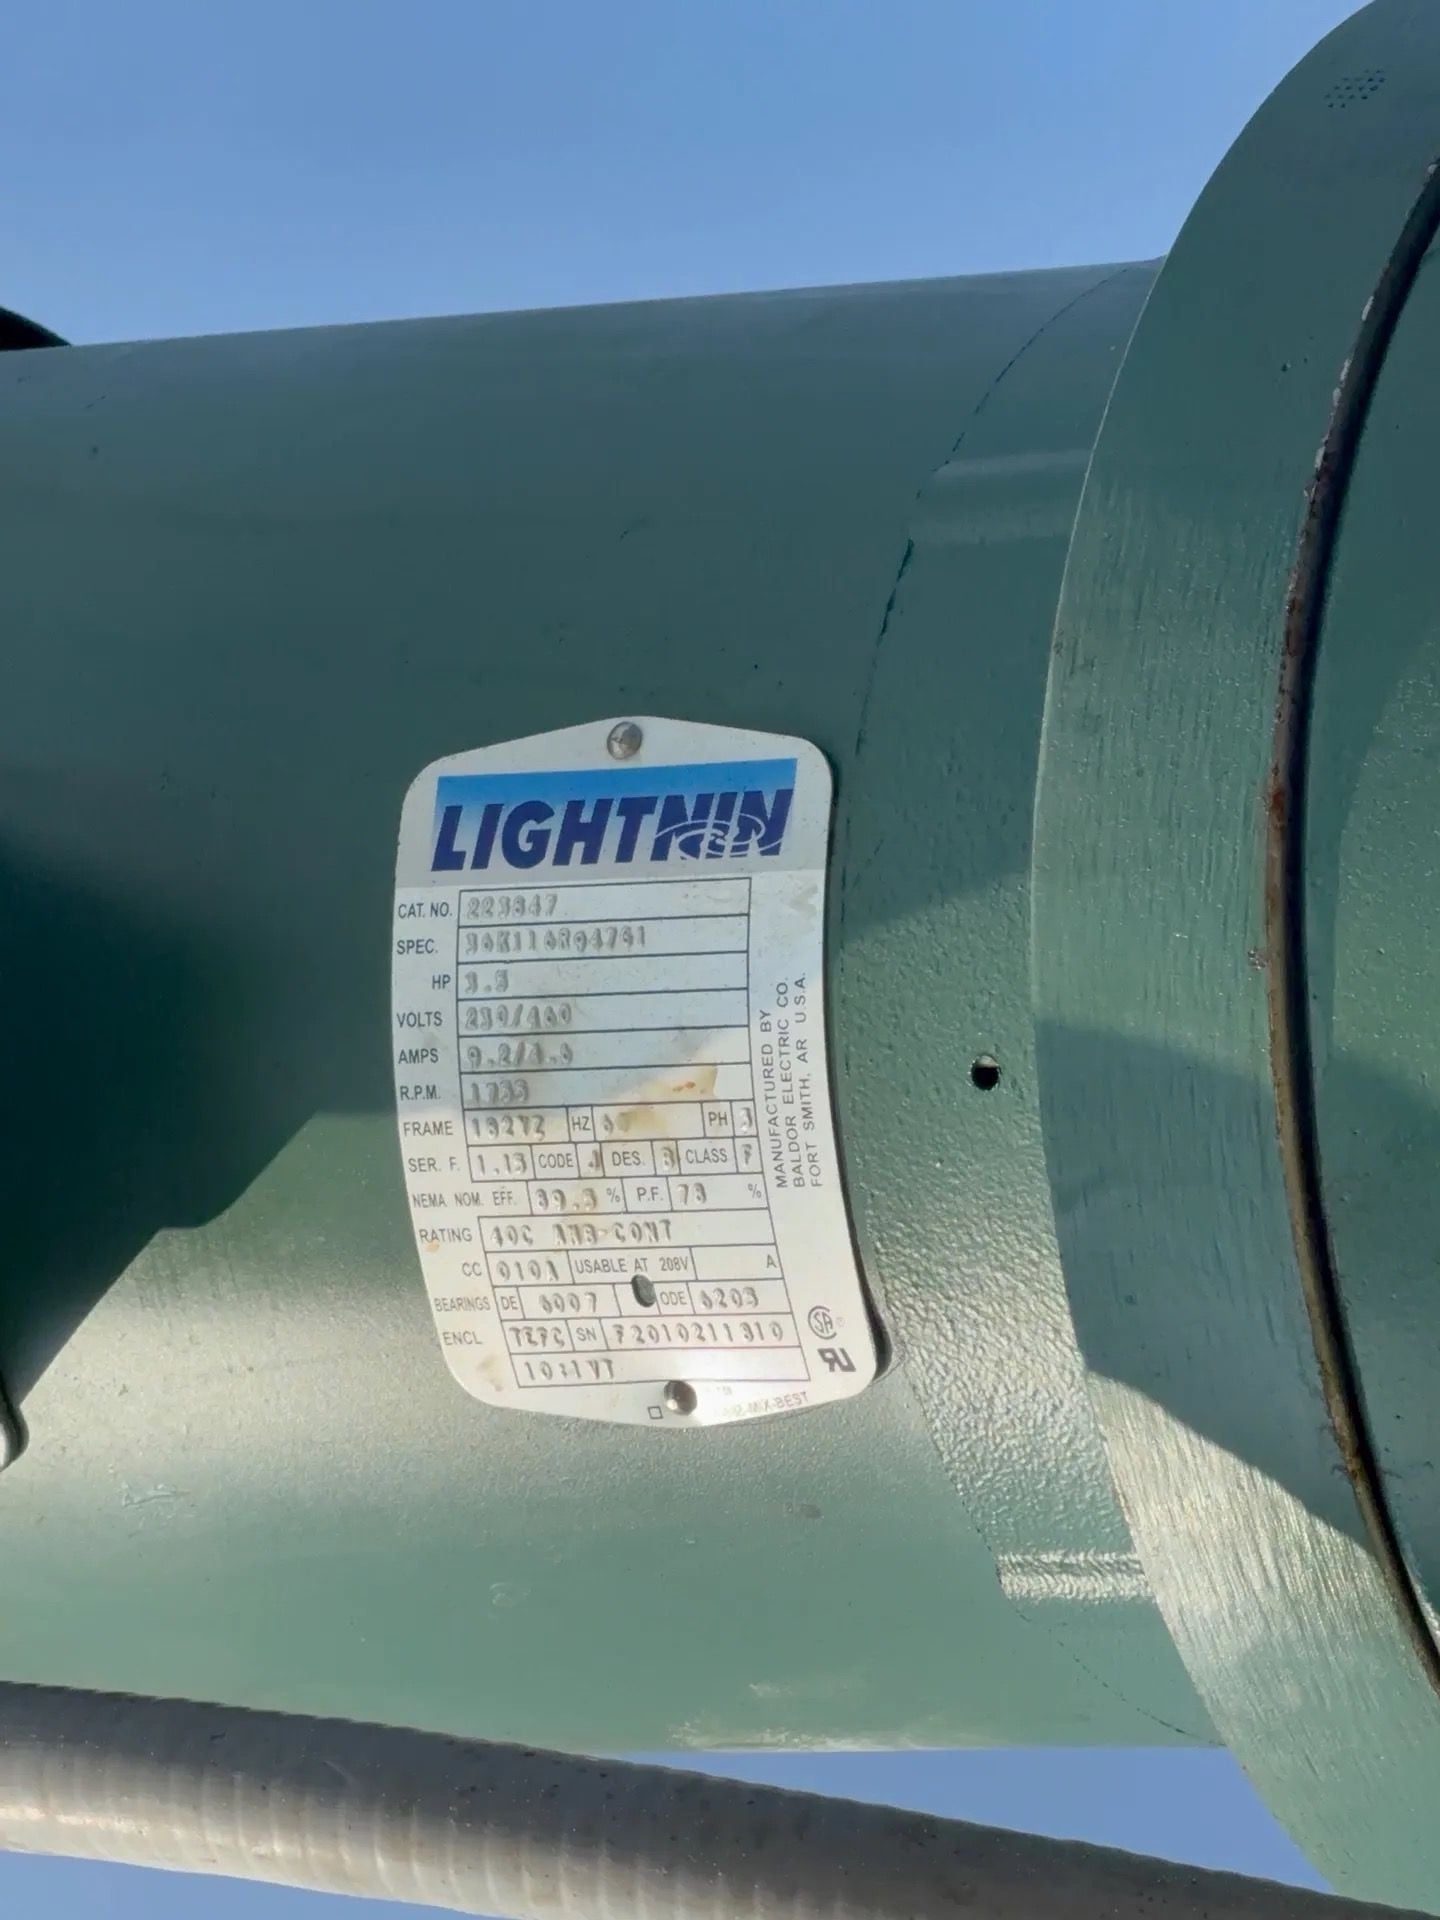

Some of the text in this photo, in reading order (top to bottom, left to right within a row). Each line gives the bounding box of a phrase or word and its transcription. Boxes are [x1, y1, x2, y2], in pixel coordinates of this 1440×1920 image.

[431, 789, 794, 871] LIGHTNIN
[398, 903, 426, 918] CAT.
[430, 902, 453, 917] NO.
[397, 939, 439, 956] SPEC.
[432, 976, 451, 990] HP
[397, 1012, 443, 1028] VOLTS
[398, 1049, 439, 1064] AMPS
[796, 1038, 808, 1063] AR
[400, 1084, 441, 1100] R.P.M.
[776, 977, 805, 1188] BALDOR ELECTRIC CO.
[759, 1009, 788, 1189] MANUFACTURED BY
[403, 1121, 454, 1136] FRAME
[571, 1115, 591, 1131] HZ
[707, 1112, 728, 1127] PH
[408, 1158, 439, 1172] SER.
[449, 1156, 461, 1170] F.
[538, 1153, 574, 1169] CODE
[611, 1151, 645, 1166] DES.
[685, 1148, 727, 1165] CLASS
[806, 1142, 823, 1188] FORT
[412, 1194, 447, 1208] NEMA
[454, 1192, 483, 1206] NOM.
[492, 1190, 517, 1205] EFF.
[606, 1187, 621, 1203] %
[636, 1185, 666, 1202] P.F.
[747, 1184, 762, 1199] %
[420, 1227, 473, 1243] RATING
[462, 1262, 482, 1277] CC
[575, 1259, 628, 1274] USABLE
[630, 1258, 650, 1273] AT
[660, 1257, 689, 1272] 208V
[766, 1254, 777, 1269] A
[435, 1296, 491, 1312] BEARINGS
[501, 1296, 518, 1311] DE
[659, 1292, 687, 1306] ODE
[443, 1331, 482, 1346] ENCL
[576, 1327, 598, 1341] SN
